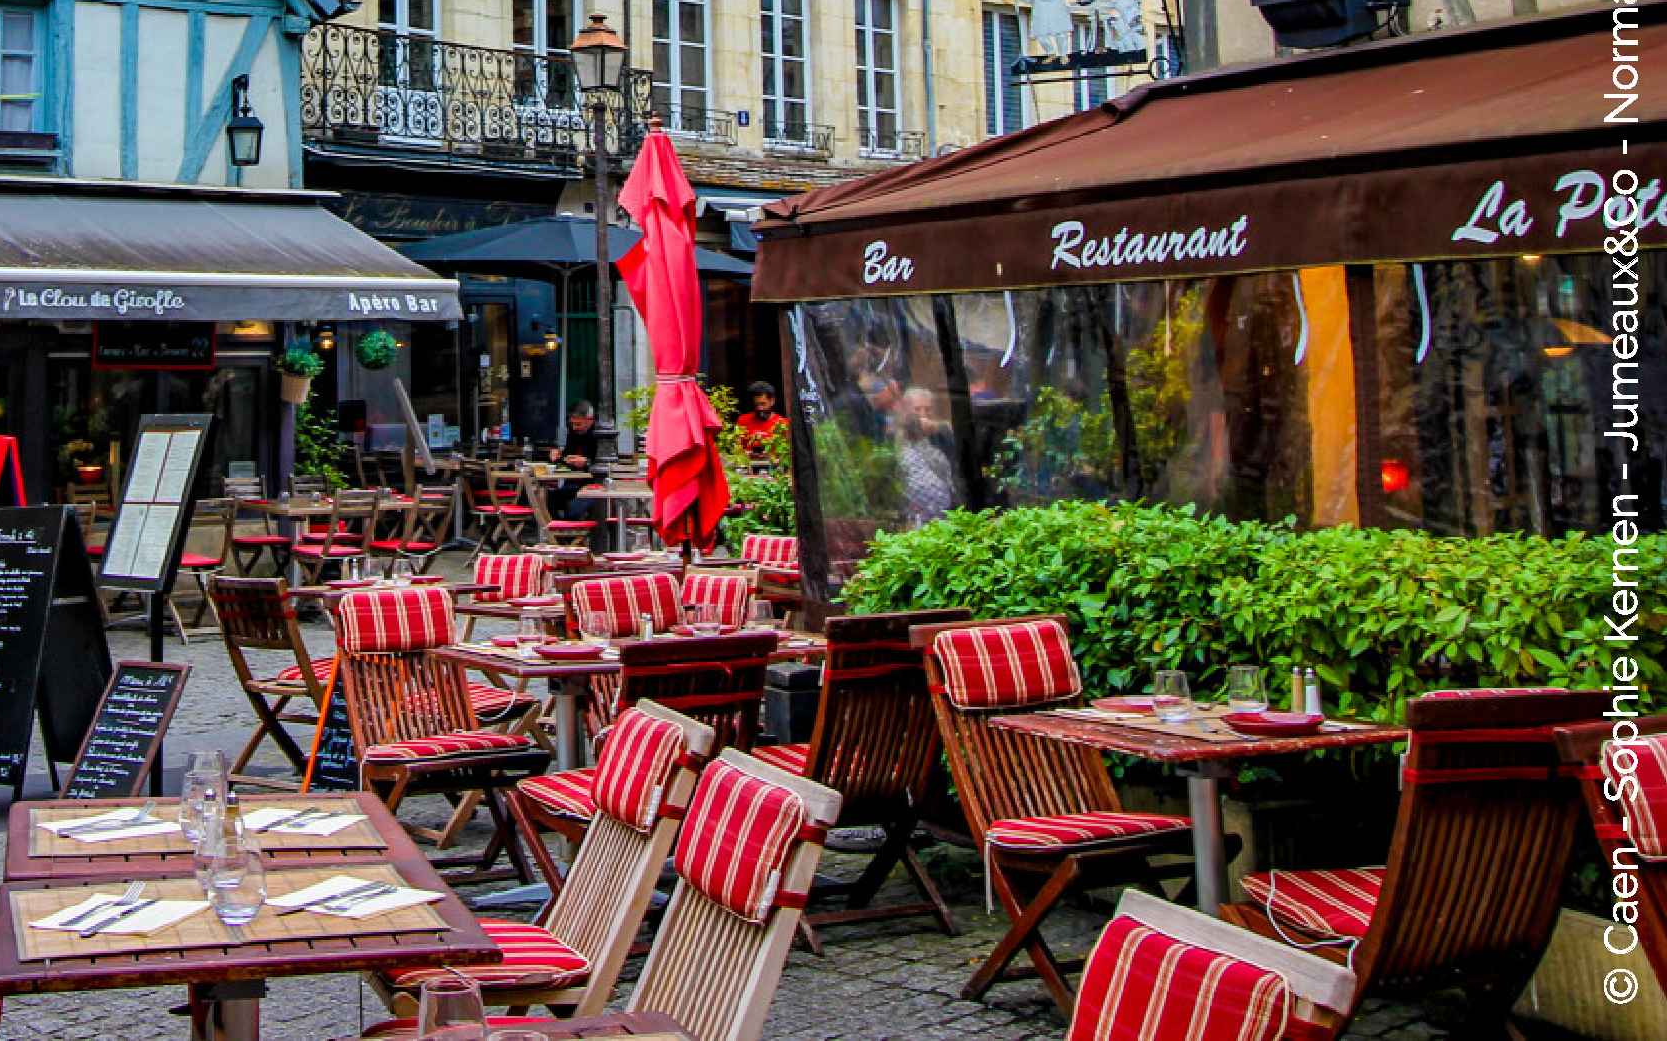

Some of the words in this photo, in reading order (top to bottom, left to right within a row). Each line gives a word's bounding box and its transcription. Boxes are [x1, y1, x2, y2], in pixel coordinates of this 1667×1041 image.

[1451, 180, 1534, 244] La
[863, 240, 915, 284] Bar
[1050, 215, 1248, 269] Restaurant
[18, 288, 38, 306] Le
[40, 288, 87, 307] Clou
[90, 290, 111, 307] de
[114, 288, 184, 315] Girofle
[405, 294, 438, 313] Bar
